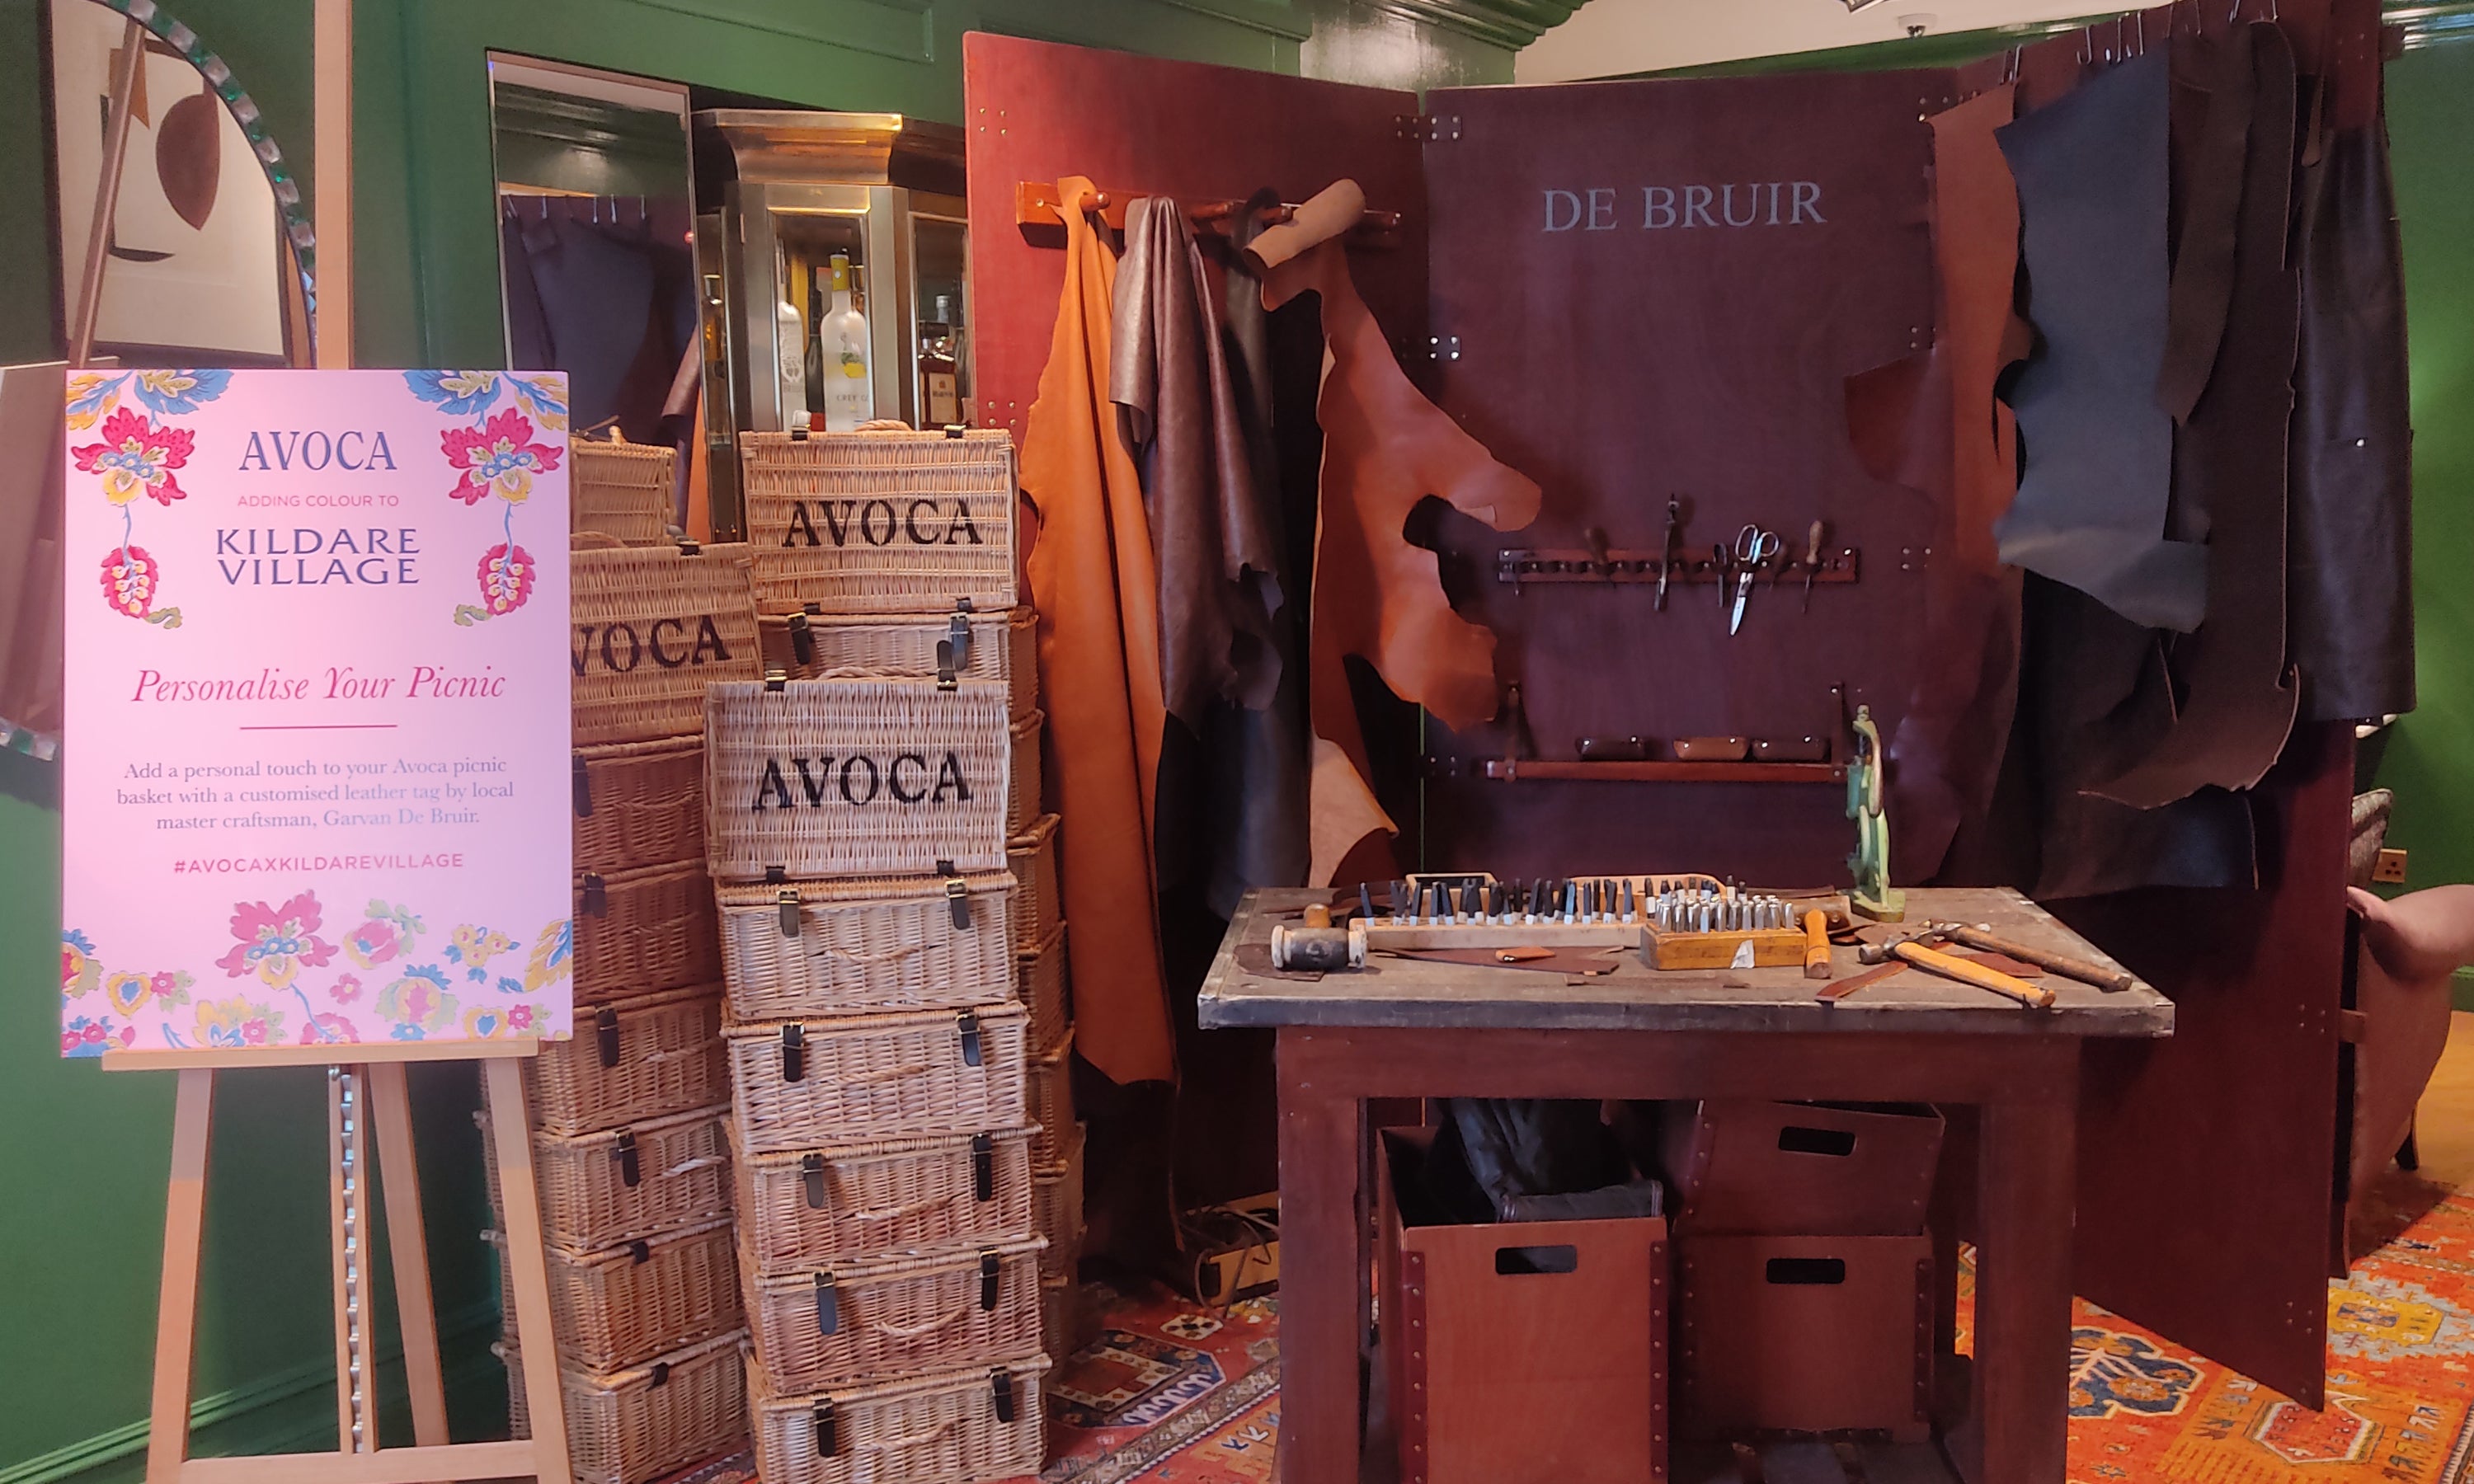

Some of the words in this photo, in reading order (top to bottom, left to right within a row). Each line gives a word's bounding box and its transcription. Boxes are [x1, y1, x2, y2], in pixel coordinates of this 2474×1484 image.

[1541, 188, 1619, 232] DE
[1641, 181, 1828, 231] BRUIR
[238, 430, 398, 472] AVOCA
[238, 495, 301, 508] ADDING
[305, 495, 374, 508] COLOUR
[378, 495, 401, 508] TO
[781, 498, 983, 548] AVOCA
[216, 528, 421, 555] KILDARE
[217, 557, 421, 586] VILLAGE
[571, 613, 733, 677] VOCA
[130, 667, 310, 702] Personalise
[322, 666, 397, 700] Your
[405, 665, 507, 699] Picnic
[124, 762, 162, 779] Add
[168, 767, 179, 778] a
[184, 760, 261, 782] personal
[267, 759, 317, 777] touch
[323, 763, 341, 775] to
[346, 763, 388, 779] your
[393, 758, 448, 774] Avoca
[454, 756, 508, 777] picnic
[750, 751, 974, 812] AVOCA
[117, 788, 172, 805] basket
[179, 787, 217, 803] with
[223, 791, 233, 802] a
[240, 785, 339, 802] customised
[345, 783, 407, 801] leather
[413, 786, 440, 802] tag
[446, 782, 468, 802] by
[473, 781, 514, 797] local
[157, 816, 218, 829] master
[223, 811, 317, 829] craftsman,
[323, 810, 392, 825] Garvan
[398, 808, 424, 824] De
[431, 807, 480, 824] Bruir.
[173, 852, 463, 874] #AVOCAXKILDAREVILLAGE
